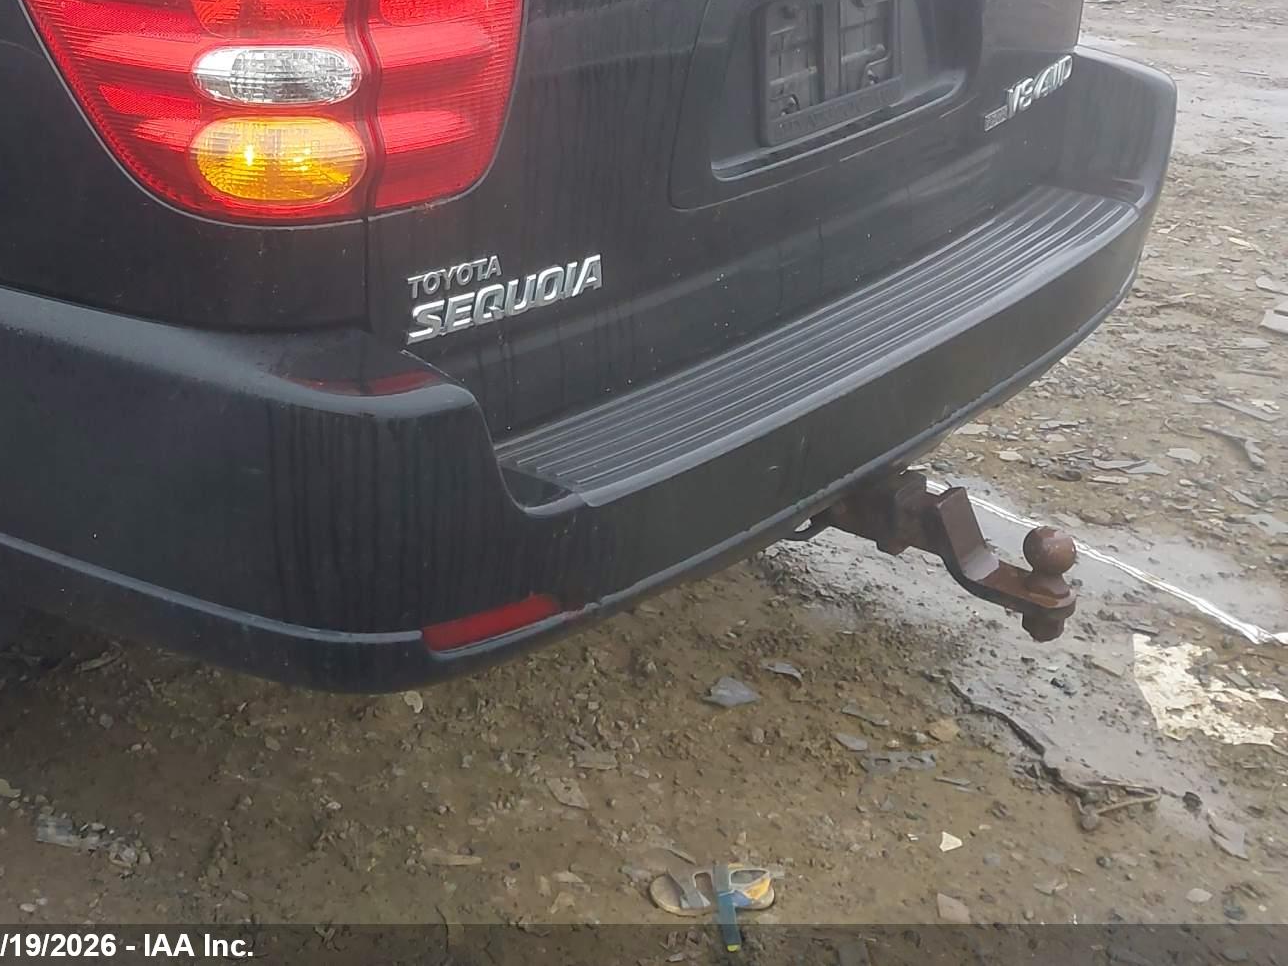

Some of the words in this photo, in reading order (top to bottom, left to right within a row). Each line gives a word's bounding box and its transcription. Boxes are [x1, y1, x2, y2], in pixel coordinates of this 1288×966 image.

[1004, 76, 1034, 118] V8
[407, 254, 502, 299] TOYOTA
[407, 254, 603, 344] SEQUOIA
